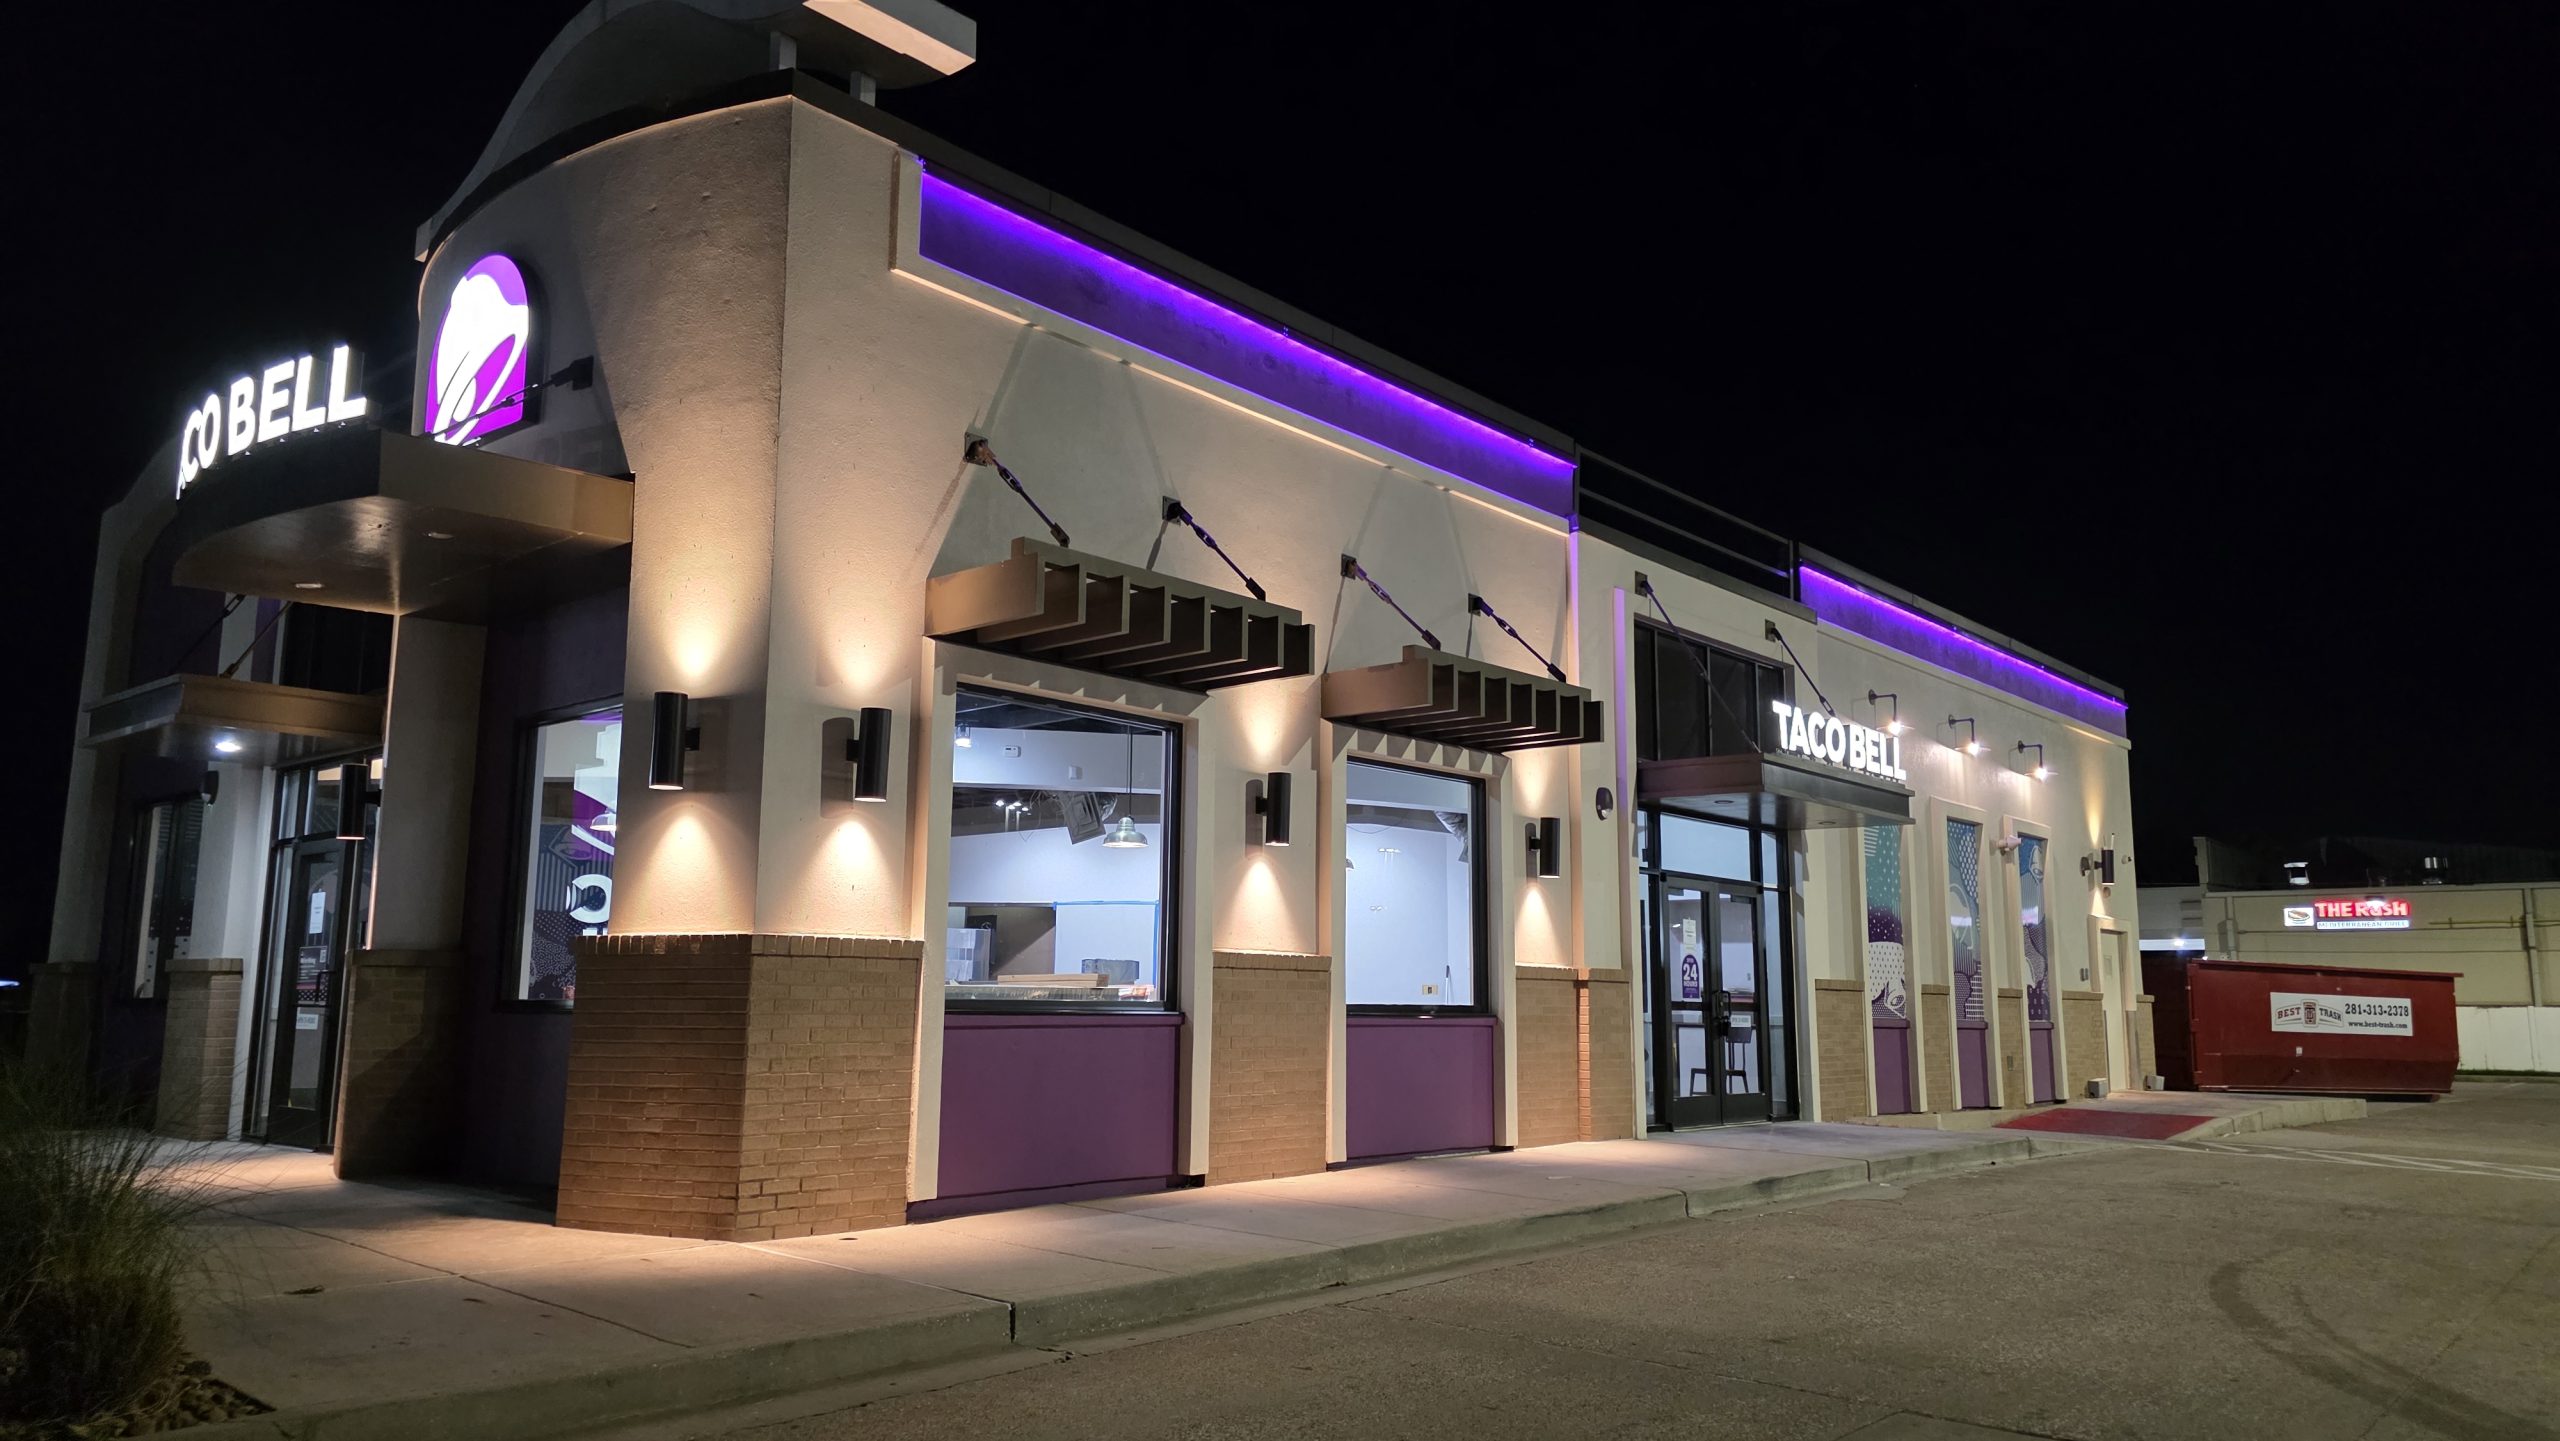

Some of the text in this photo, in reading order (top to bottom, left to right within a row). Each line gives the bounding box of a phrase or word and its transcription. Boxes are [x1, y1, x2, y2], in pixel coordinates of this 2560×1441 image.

[228, 345, 367, 456] BELL
[1772, 700, 1907, 781] TACO BELL
[2314, 900, 2408, 917] THE RUSH
[1683, 963, 1698, 981] 24
[2277, 1006, 2301, 1019] BEST
[2319, 1007, 2342, 1021] TRASH
[2345, 1003, 2409, 1017] 281-313-2378
[2348, 1021, 2408, 1029] www.best-trash.com
